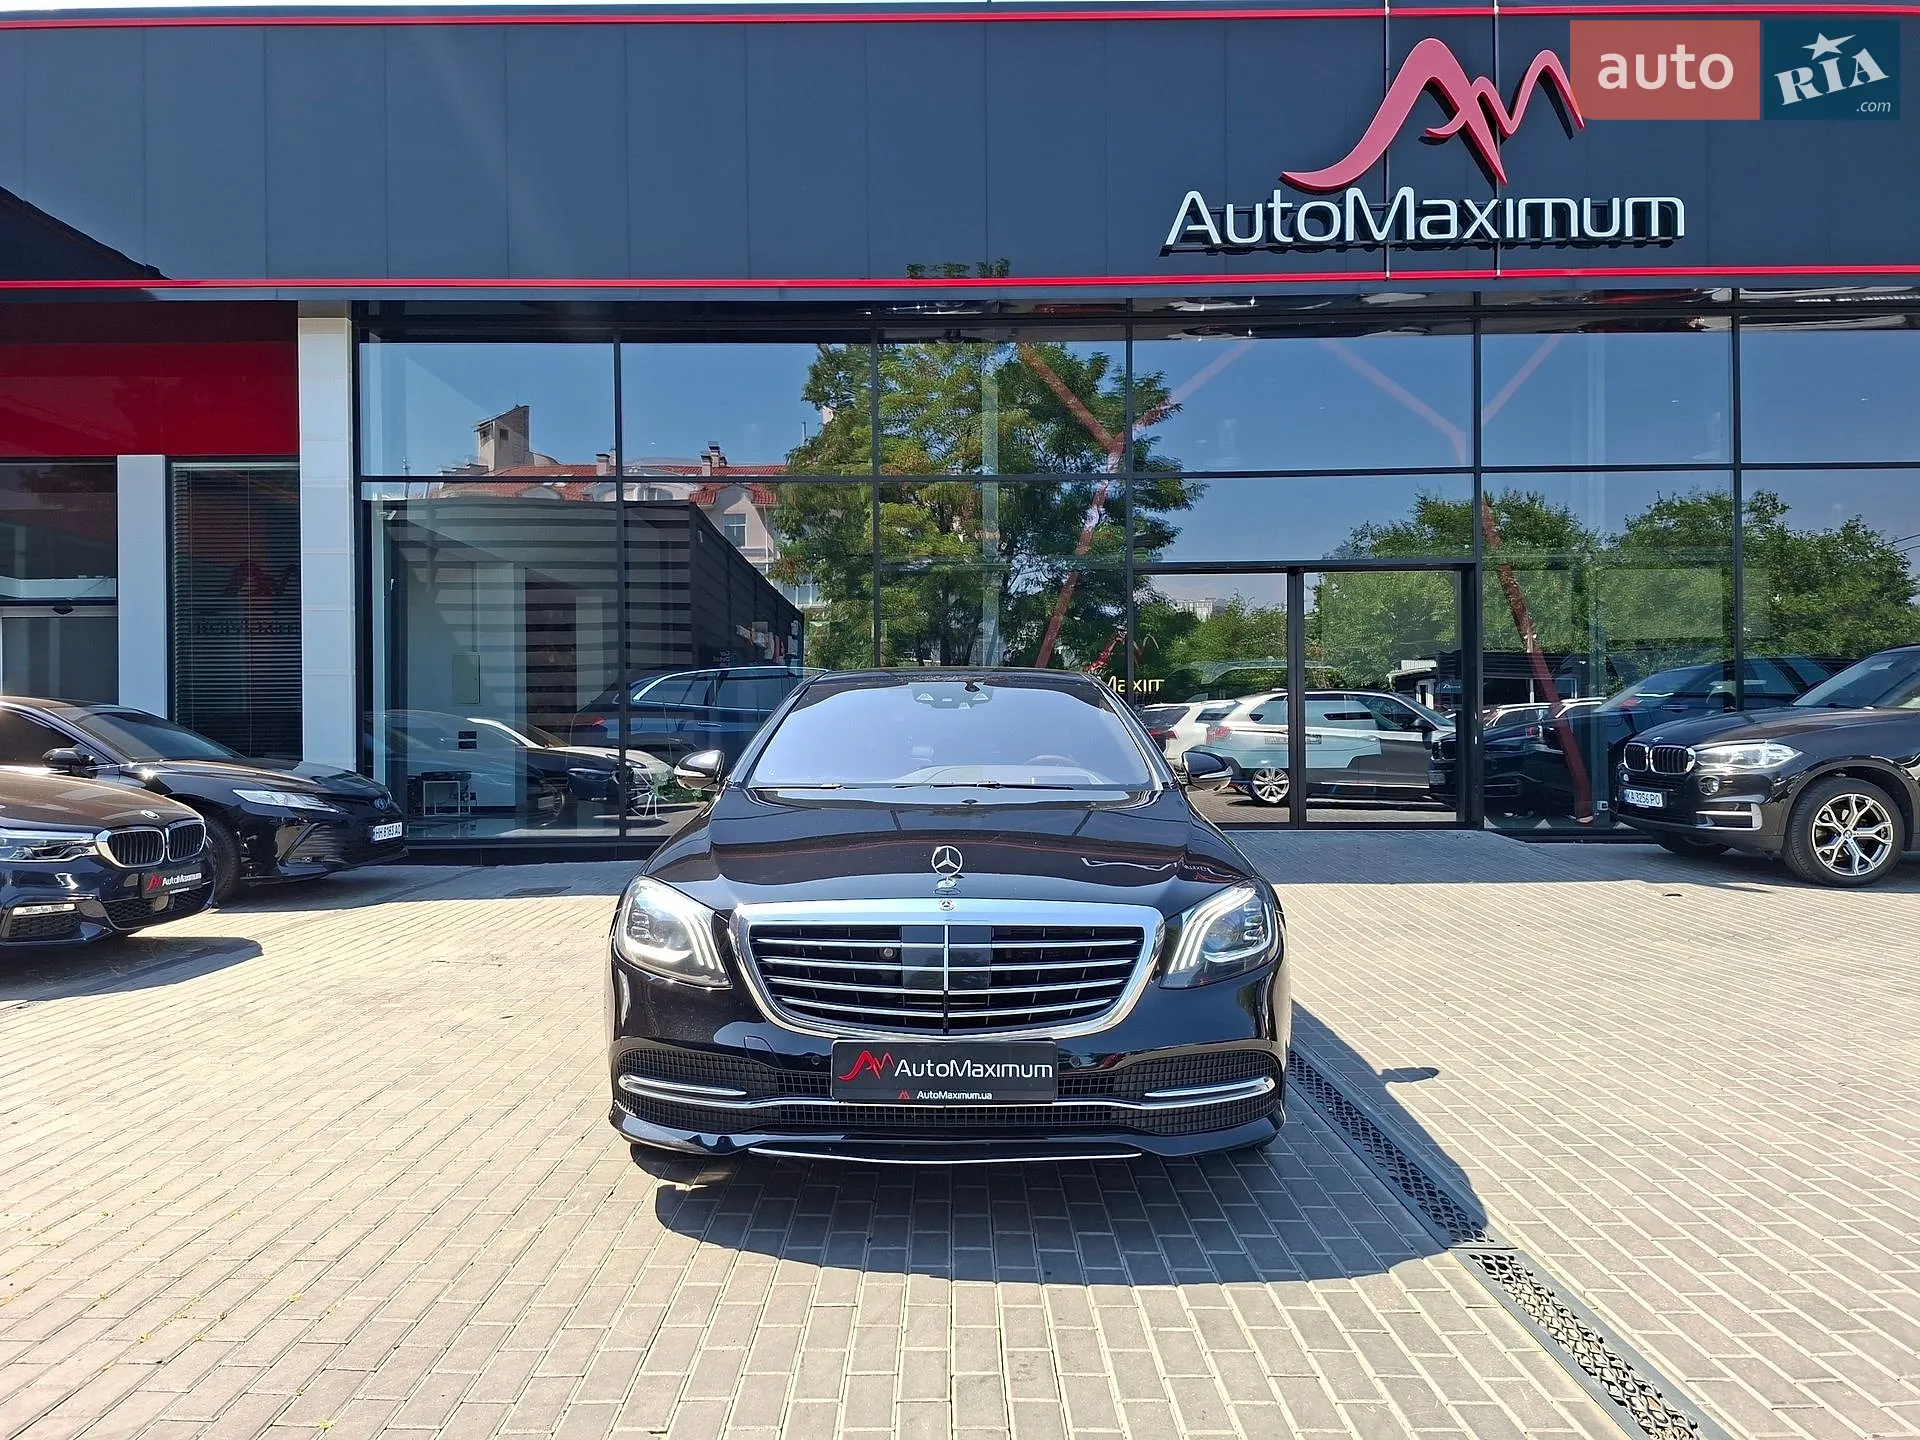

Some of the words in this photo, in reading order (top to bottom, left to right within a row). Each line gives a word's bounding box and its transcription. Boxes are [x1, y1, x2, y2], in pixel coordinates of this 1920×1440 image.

[1165, 186, 1686, 246] AutoMaximum
[894, 1059, 1053, 1078] AutoMaximum
[917, 1090, 993, 1100] AutoMaximum.ua
